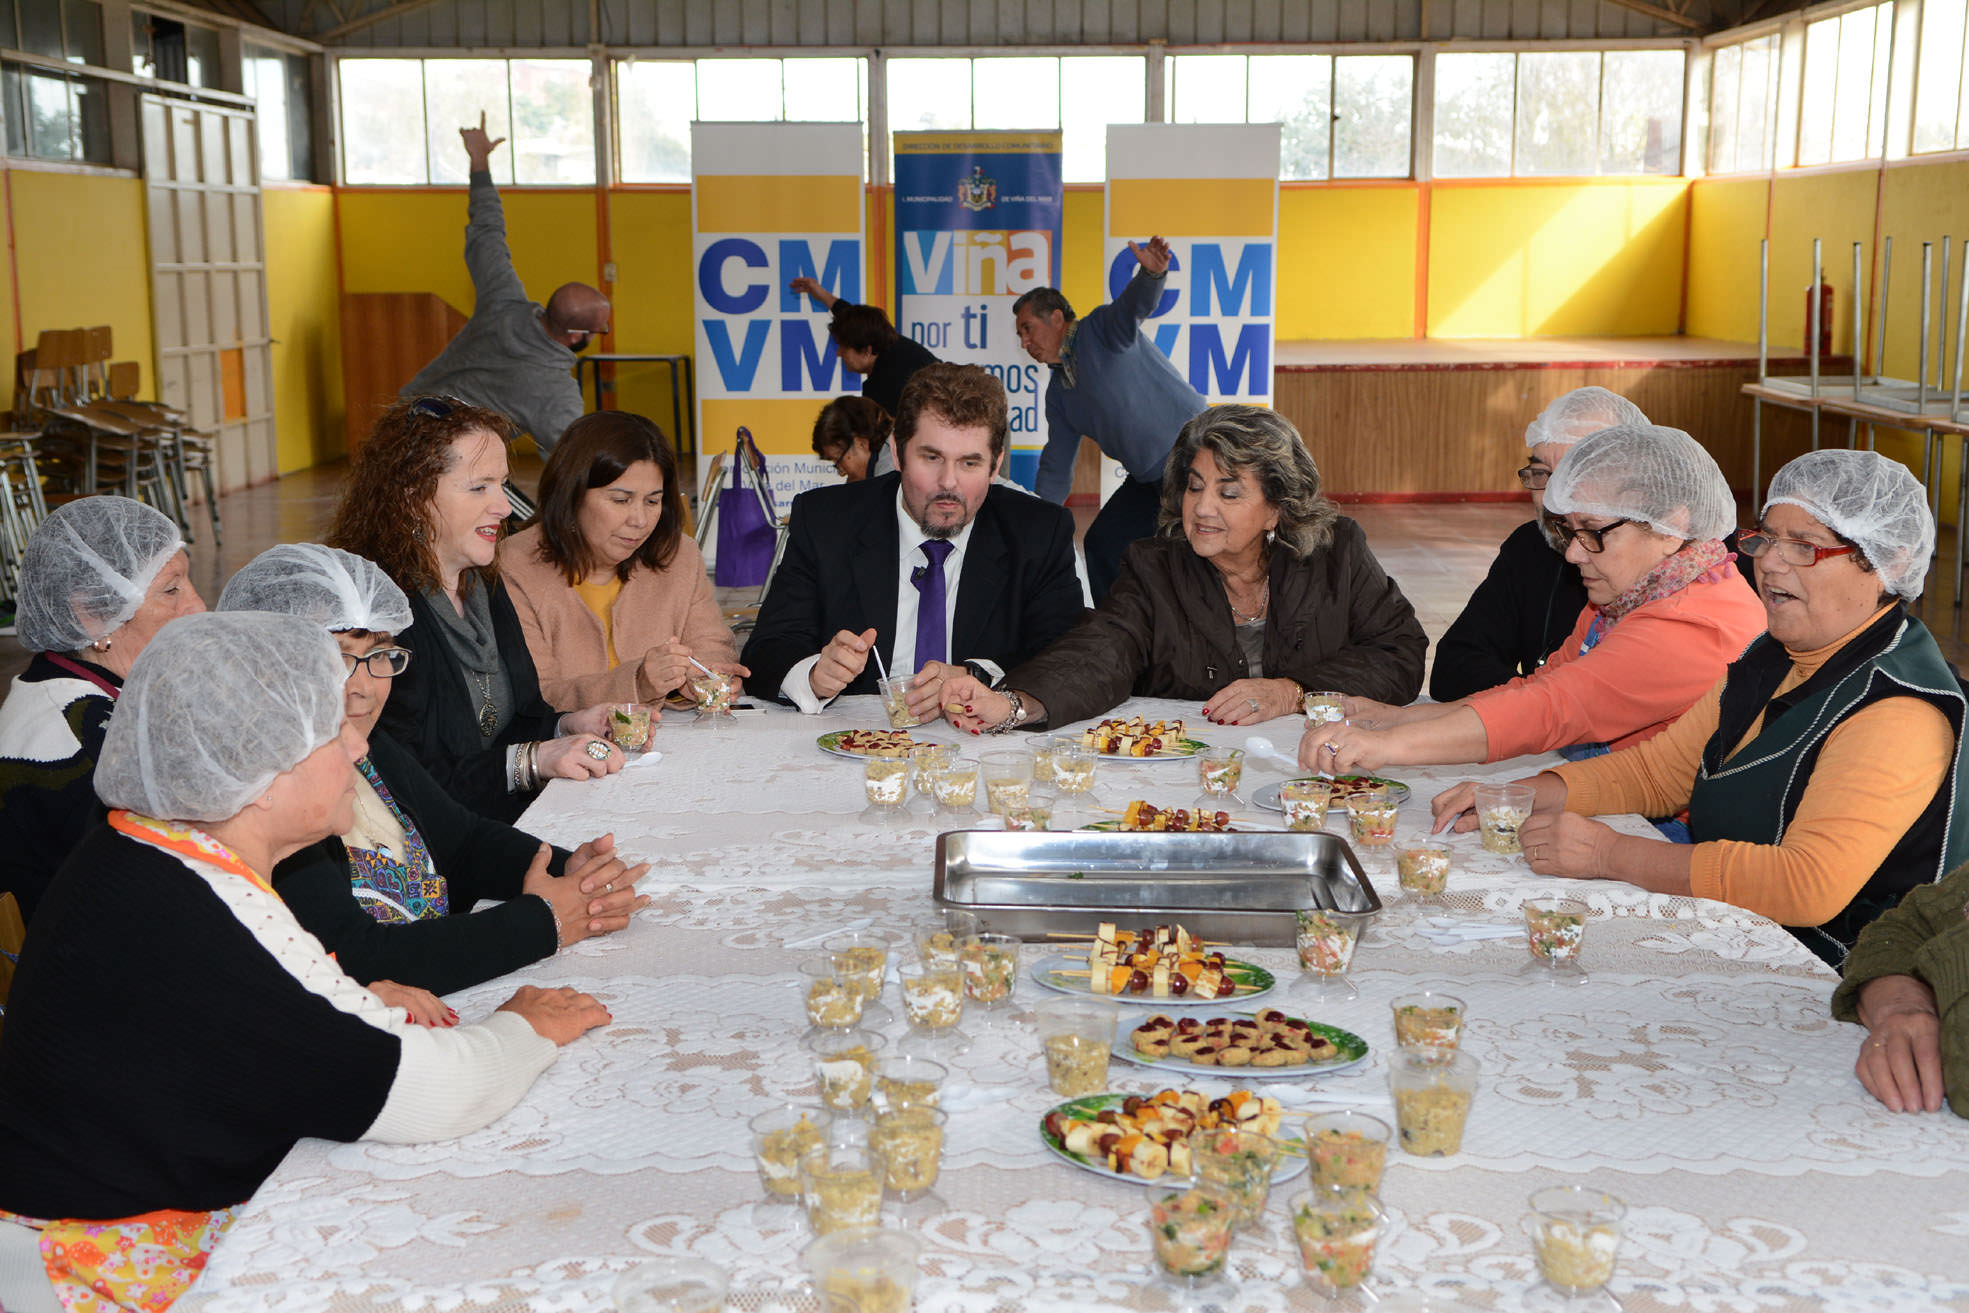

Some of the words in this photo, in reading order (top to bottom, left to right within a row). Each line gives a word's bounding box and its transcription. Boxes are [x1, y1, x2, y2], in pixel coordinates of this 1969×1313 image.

[907, 195, 953, 203] MUNICIPALIDAD
[698, 238, 860, 315] CM
[903, 231, 1050, 295] Viña
[961, 303, 988, 349] ti
[776, 480, 795, 491] del
